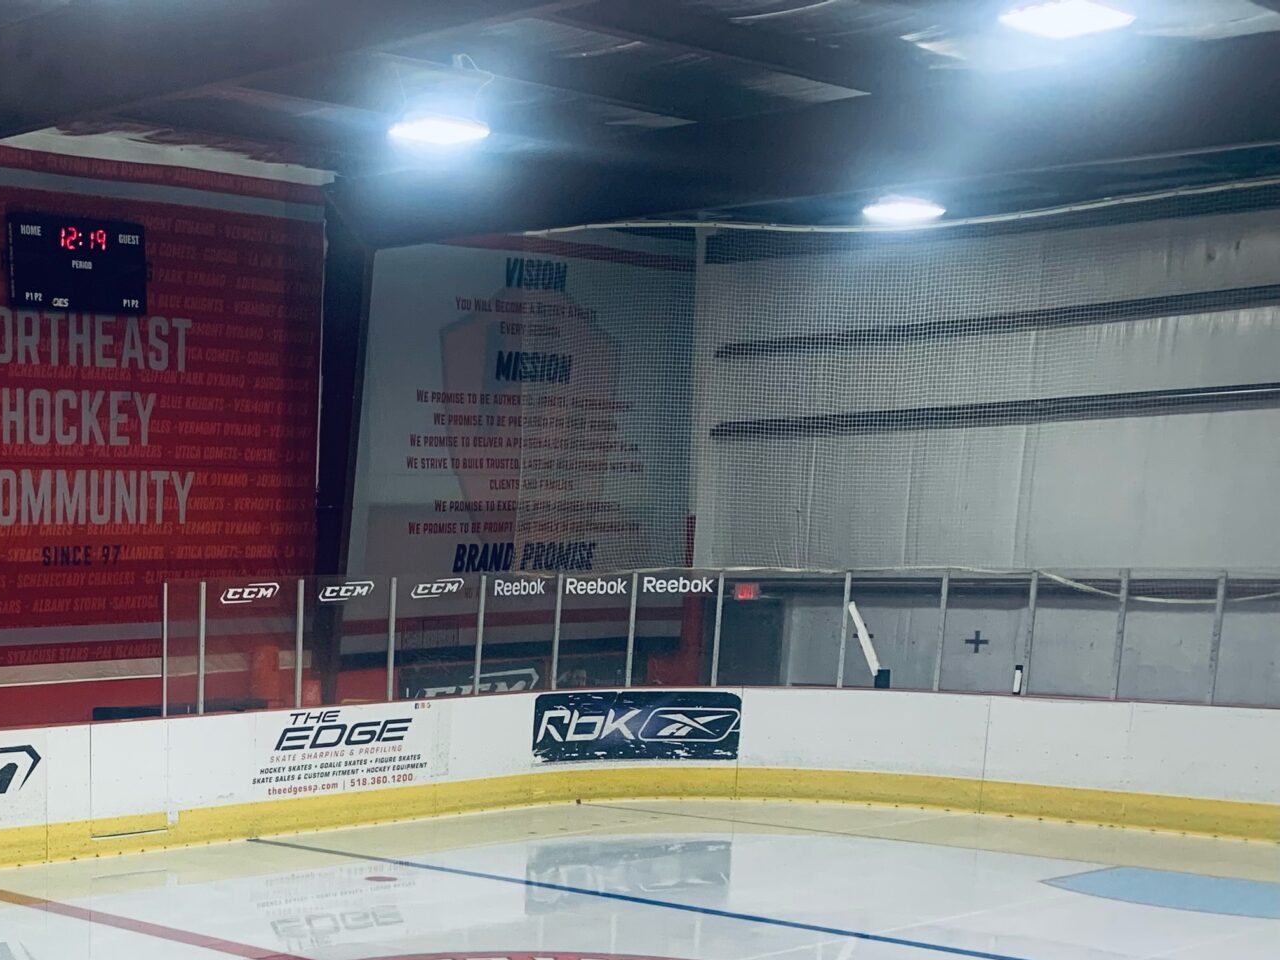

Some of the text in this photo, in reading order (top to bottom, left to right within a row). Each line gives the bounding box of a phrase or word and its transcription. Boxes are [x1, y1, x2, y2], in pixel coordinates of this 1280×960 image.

[20, 224, 41, 236] HOME
[60, 227, 106, 250] 12:19
[118, 233, 140, 245] GUEST
[71, 259, 93, 270] PERIOD
[505, 257, 568, 291] VISION
[495, 350, 572, 386] MISSION
[1, 387, 157, 446] HOCKEY
[42, 545, 92, 566] SINCE
[452, 542, 516, 573] BRAND
[225, 585, 276, 601] CCM
[323, 584, 370, 599] CCM
[415, 580, 460, 595] CCM
[494, 579, 546, 596] Reebok
[565, 578, 628, 595] Reebok
[643, 576, 714, 593] Reebok
[290, 710, 341, 725] THE
[274, 718, 413, 751] EDGE
[270, 753, 296, 763] SKATE
[301, 750, 345, 761] SHARPING
[359, 745, 403, 756] PROFILING
[260, 753, 421, 775] HOCKEY SKATES GOALIE SKATES FIGURE SKATES
[252, 777, 273, 785] SKATE
[275, 775, 296, 783] SALES
[304, 771, 331, 780] CUSTOM
[332, 768, 360, 777] FITMENT
[366, 765, 391, 774] HOCKEY
[392, 762, 428, 772] EQUIPMENT
[350, 773, 414, 788] 518.360.1200
